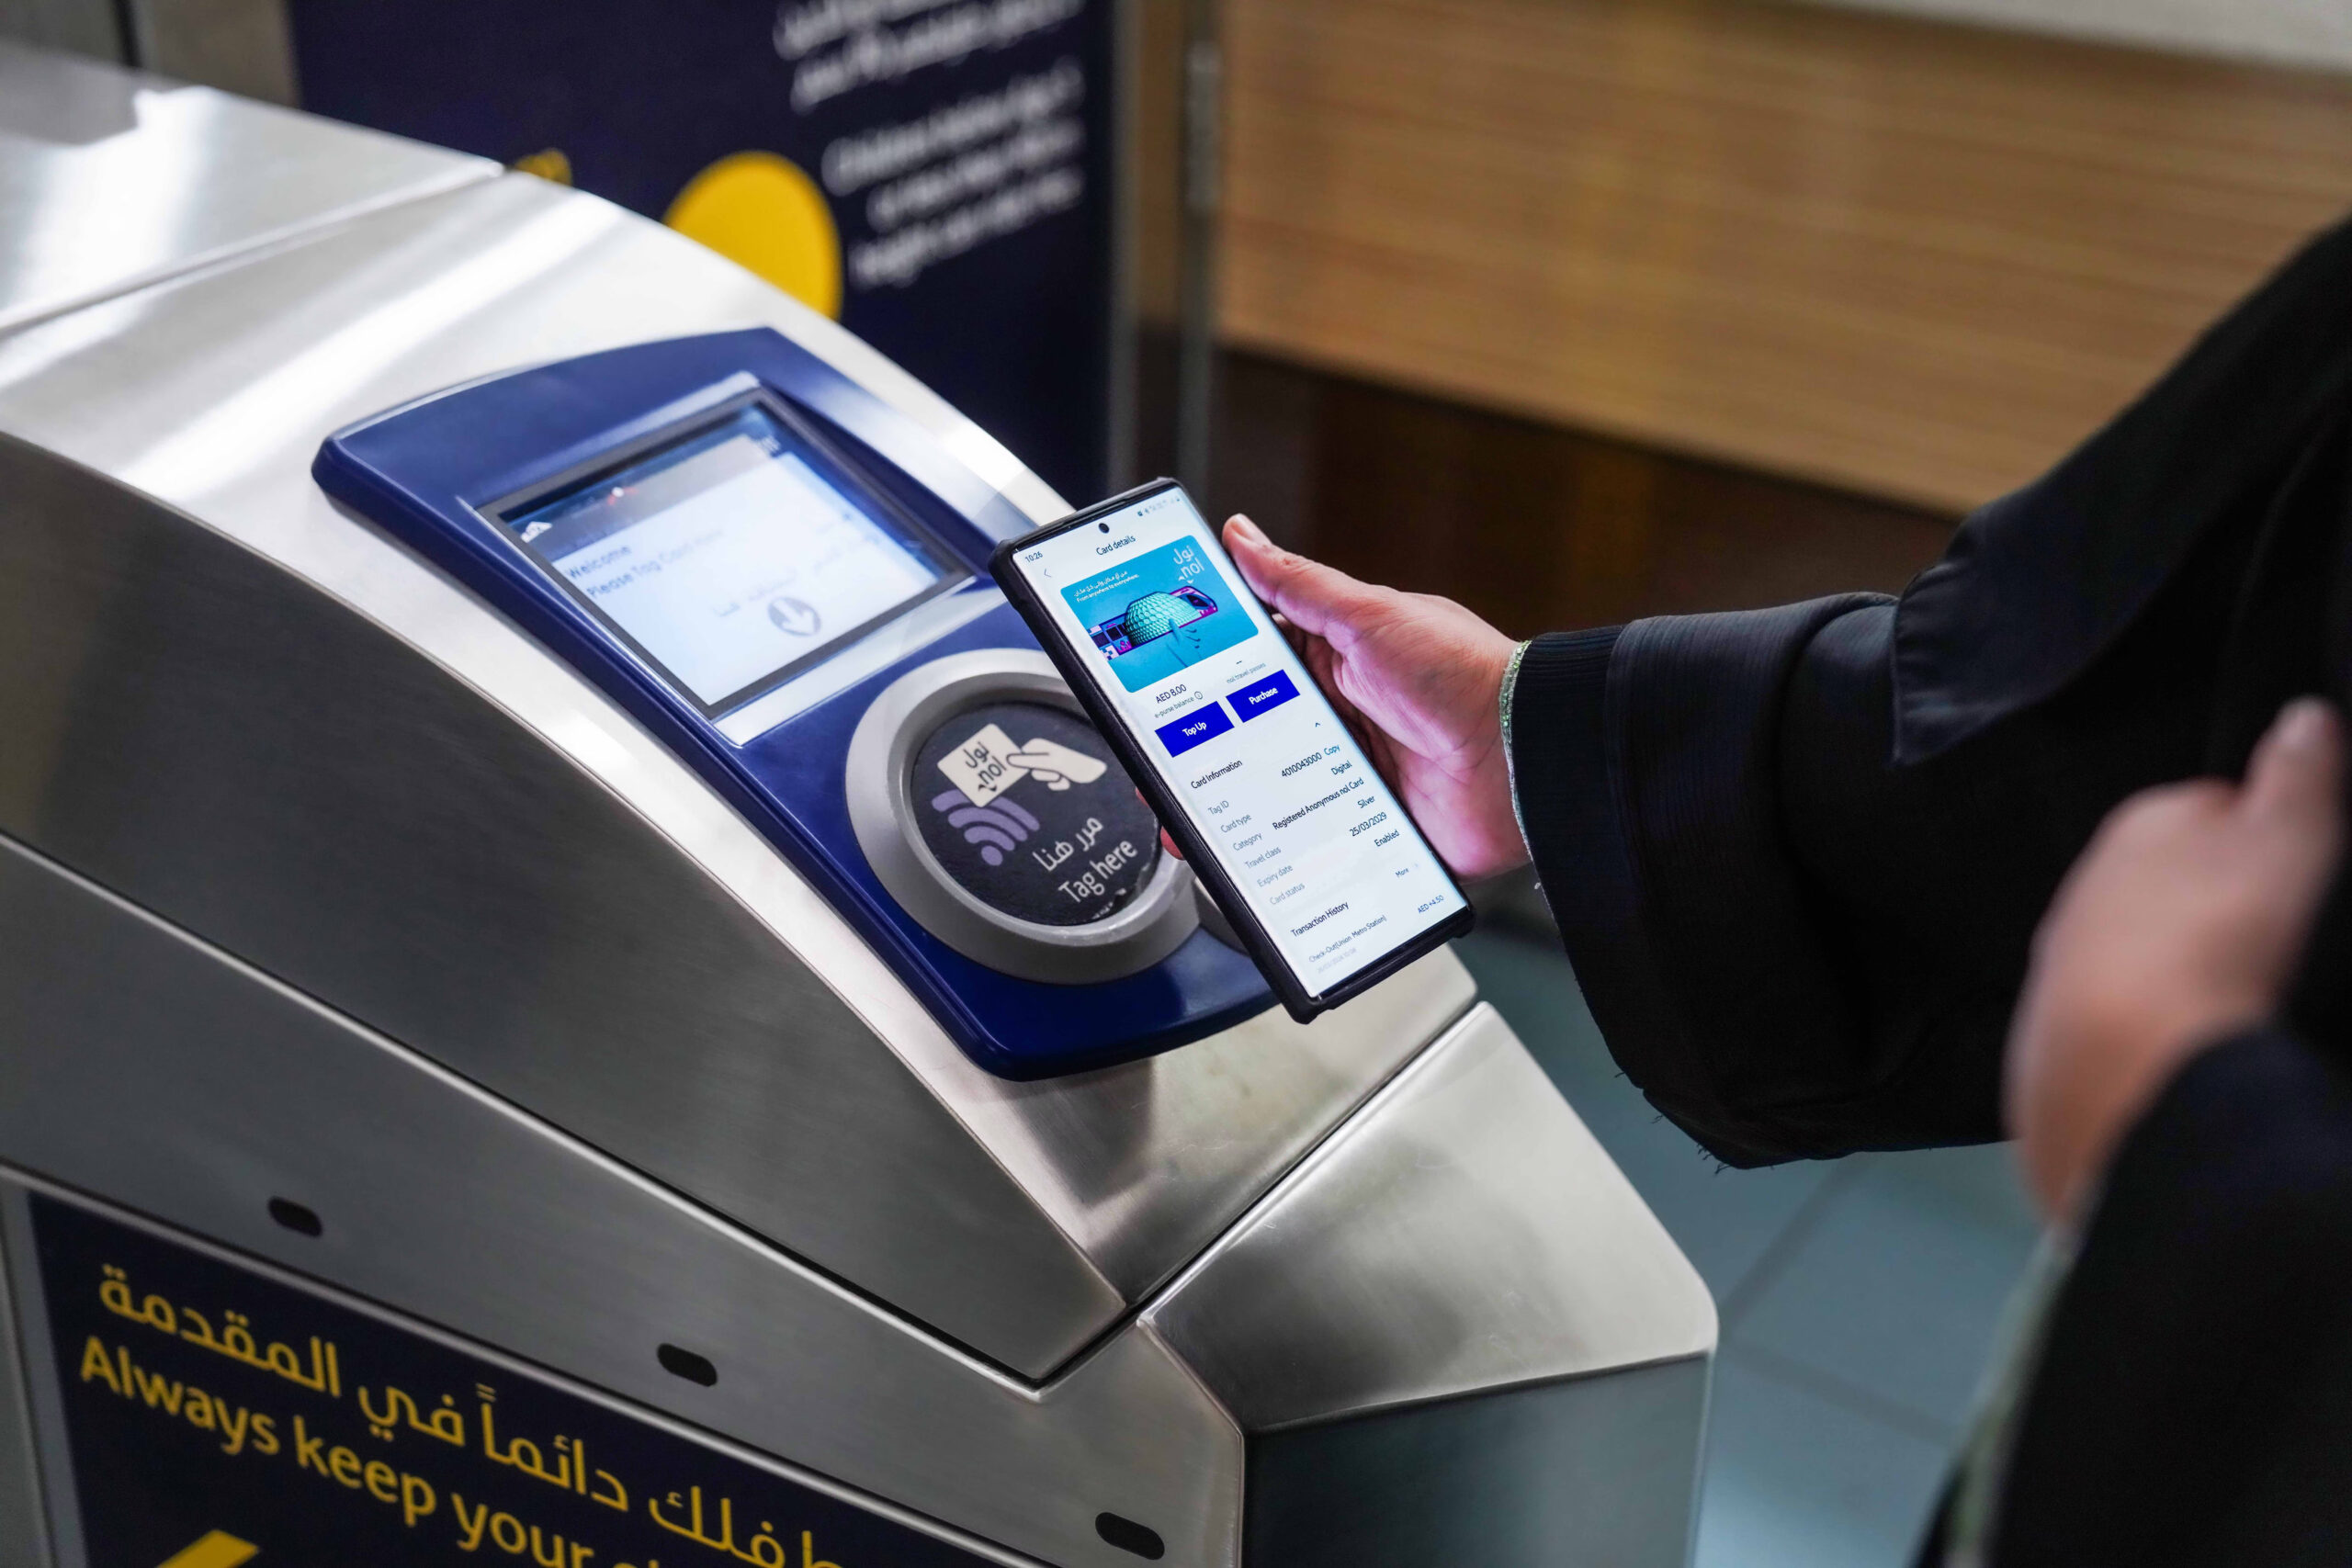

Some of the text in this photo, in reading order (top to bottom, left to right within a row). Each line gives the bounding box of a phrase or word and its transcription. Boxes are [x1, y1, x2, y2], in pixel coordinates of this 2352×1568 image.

[1096, 535, 1136, 557] Card details
[1172, 544, 1195, 565] نول
[569, 546, 632, 579] Welcome
[1024, 551, 1044, 564] 10:26
[1181, 560, 1204, 579] nol
[587, 573, 633, 597] Please
[1155, 683, 1187, 704] AED 8.00
[1173, 697, 1194, 711] balance
[1249, 686, 1279, 705] Purchase
[1182, 721, 1207, 737] Top Up
[963, 741, 989, 769] نول
[1281, 744, 1340, 778] 4010043000 Copy
[977, 756, 1007, 784] nol
[1191, 759, 1243, 790] Card Information
[1330, 760, 1352, 776] Digital
[1208, 800, 1229, 818] Tag ID
[1272, 778, 1364, 831] Registered Anonymous nol Card
[1357, 795, 1375, 810] Silver
[1221, 814, 1251, 834] Card type
[1350, 812, 1387, 838] 25/03/2029
[1032, 818, 1104, 872] مرر هنا
[1233, 833, 1262, 852] Category
[1374, 830, 1400, 848] Enabled
[1245, 847, 1282, 870] Travel class
[1058, 840, 1137, 902] Tag here
[1257, 865, 1294, 889] Expiry date
[1396, 867, 1409, 878] More
[1270, 883, 1306, 906] Card status
[1291, 901, 1350, 938] Transaction History
[1418, 903, 1430, 914] AED
[1351, 925, 1368, 938] Metro
[98, 1263, 341, 1398] المقدمة
[358, 1385, 465, 1447] في
[81, 1336, 594, 1568] Always keep your
